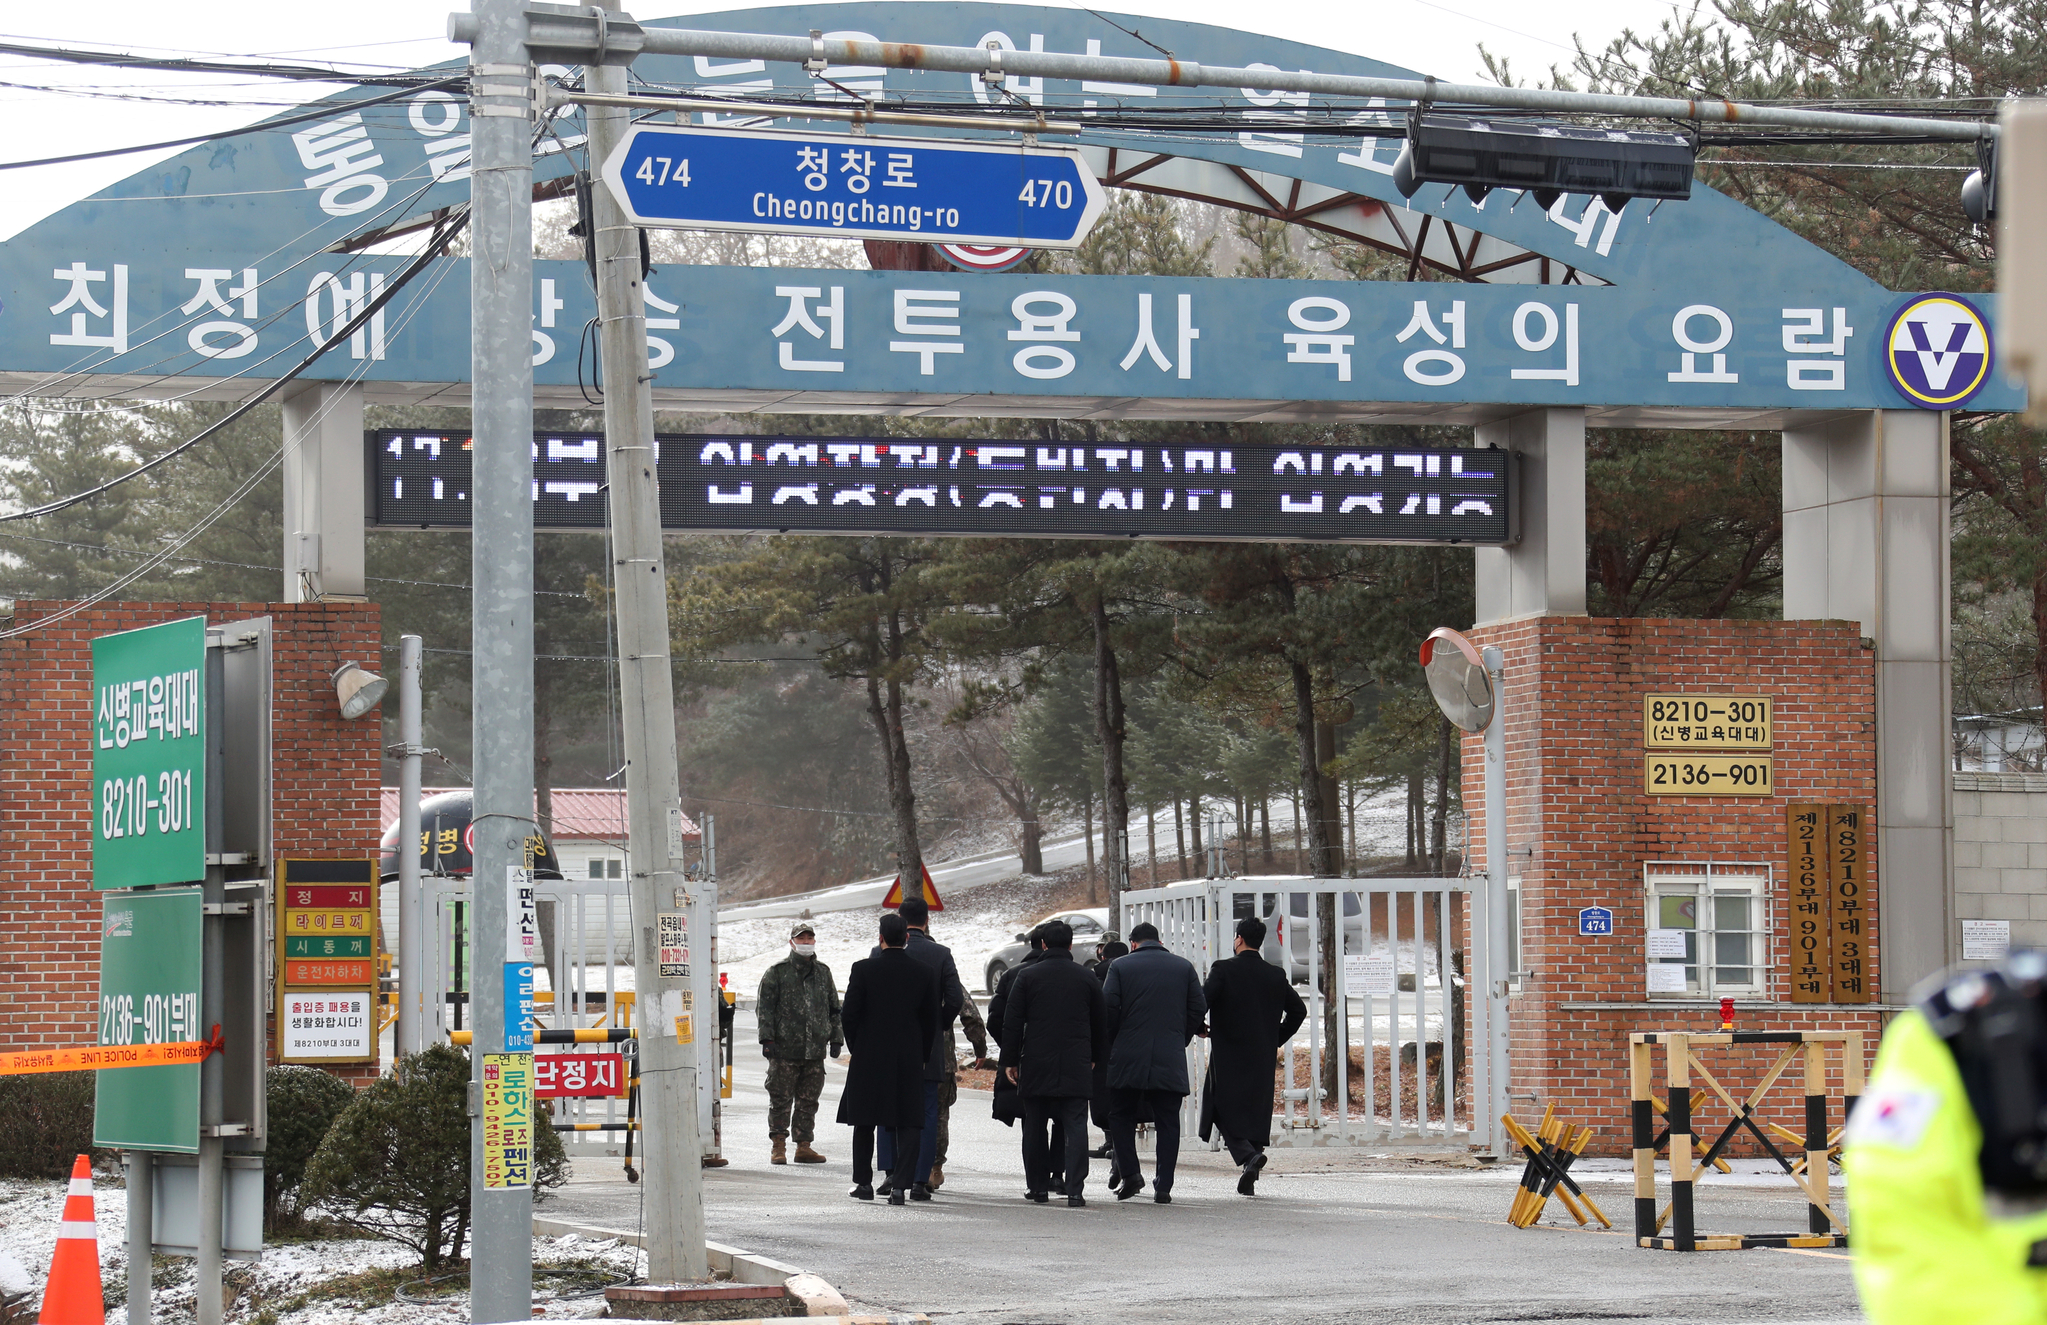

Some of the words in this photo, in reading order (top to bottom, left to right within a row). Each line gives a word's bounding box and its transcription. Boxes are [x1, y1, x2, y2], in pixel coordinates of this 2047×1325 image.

[635, 157, 691, 187] 474
[796, 146, 918, 191] 청창로
[1018, 179, 1072, 210] 470
[752, 192, 960, 231] Cheongchang-ro
[771, 285, 1200, 380] 전투용사
[1283, 296, 1579, 387] 육성의
[1668, 304, 1854, 391] 요람
[98, 668, 199, 750] 신병교육대대
[1651, 701, 1766, 723] 8210-301
[1652, 725, 1767, 743] (신병교육대대)
[1653, 763, 1768, 786] 2136-901
[102, 769, 192, 840] 8210-301
[1793, 811, 1822, 915] 제2136부대
[1835, 811, 1863, 936] 제8210부대
[296, 914, 363, 929] 라이트꺼
[1585, 920, 1606, 931] 474
[296, 964, 364, 979] 운전자하차
[1795, 919, 1822, 995] 901부대
[1838, 941, 1863, 995] 3대대
[102, 992, 197, 1046] 2136-901부대
[291, 1016, 363, 1029] 생활화합시다!
[292, 1001, 325, 1014] 출입증
[328, 1001, 361, 1013] 패용을
[81, 1052, 101, 1064] LINE
[104, 1050, 137, 1062] POLICE
[294, 1039, 338, 1048] 제8210부대
[339, 1039, 360, 1047] 3대대
[503, 1147, 528, 1187] 펜션
